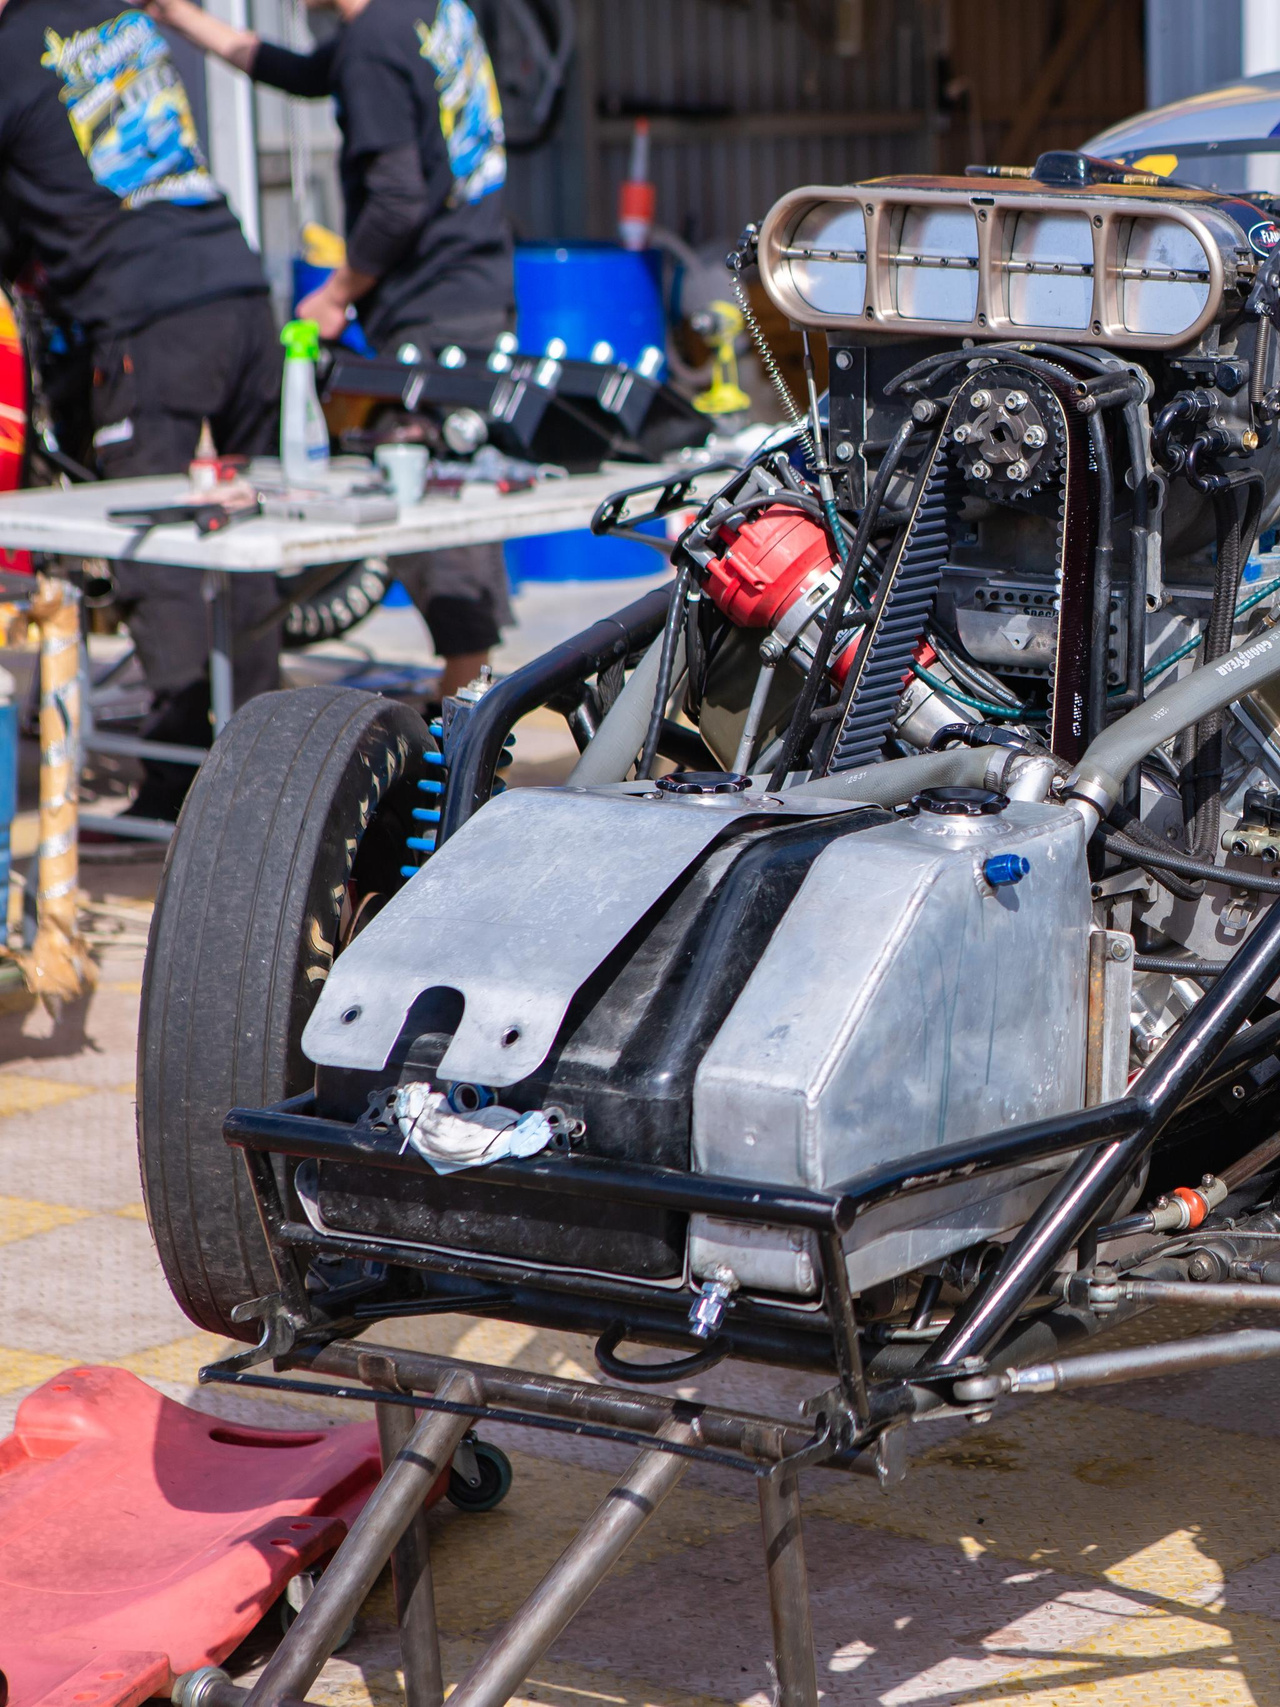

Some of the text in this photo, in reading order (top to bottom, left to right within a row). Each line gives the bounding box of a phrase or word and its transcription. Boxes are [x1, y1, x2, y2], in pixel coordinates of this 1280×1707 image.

[1215, 640, 1273, 676] GOODYEAR
[966, 666, 1013, 701] SUPER CONDUCTOR
